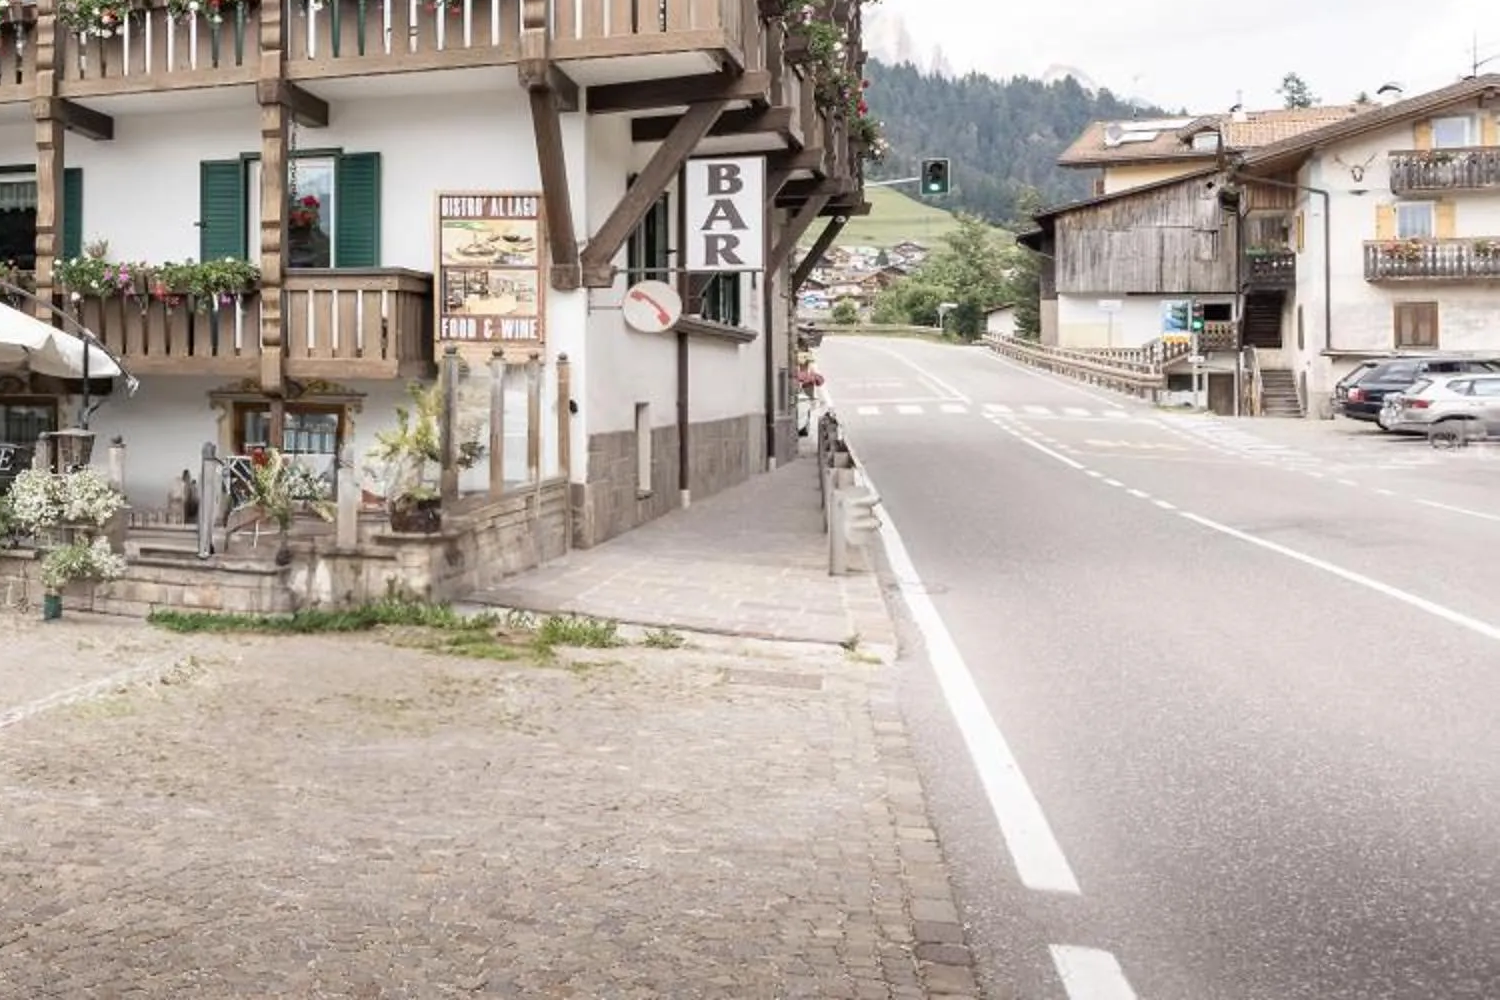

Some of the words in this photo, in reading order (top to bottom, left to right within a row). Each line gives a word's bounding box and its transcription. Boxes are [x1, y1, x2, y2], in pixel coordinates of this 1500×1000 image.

[490, 197, 505, 216] AL
[701, 163, 748, 266] BAR
[441, 318, 477, 339] FOOD
[483, 318, 493, 339] &
[501, 318, 538, 339] WINE
